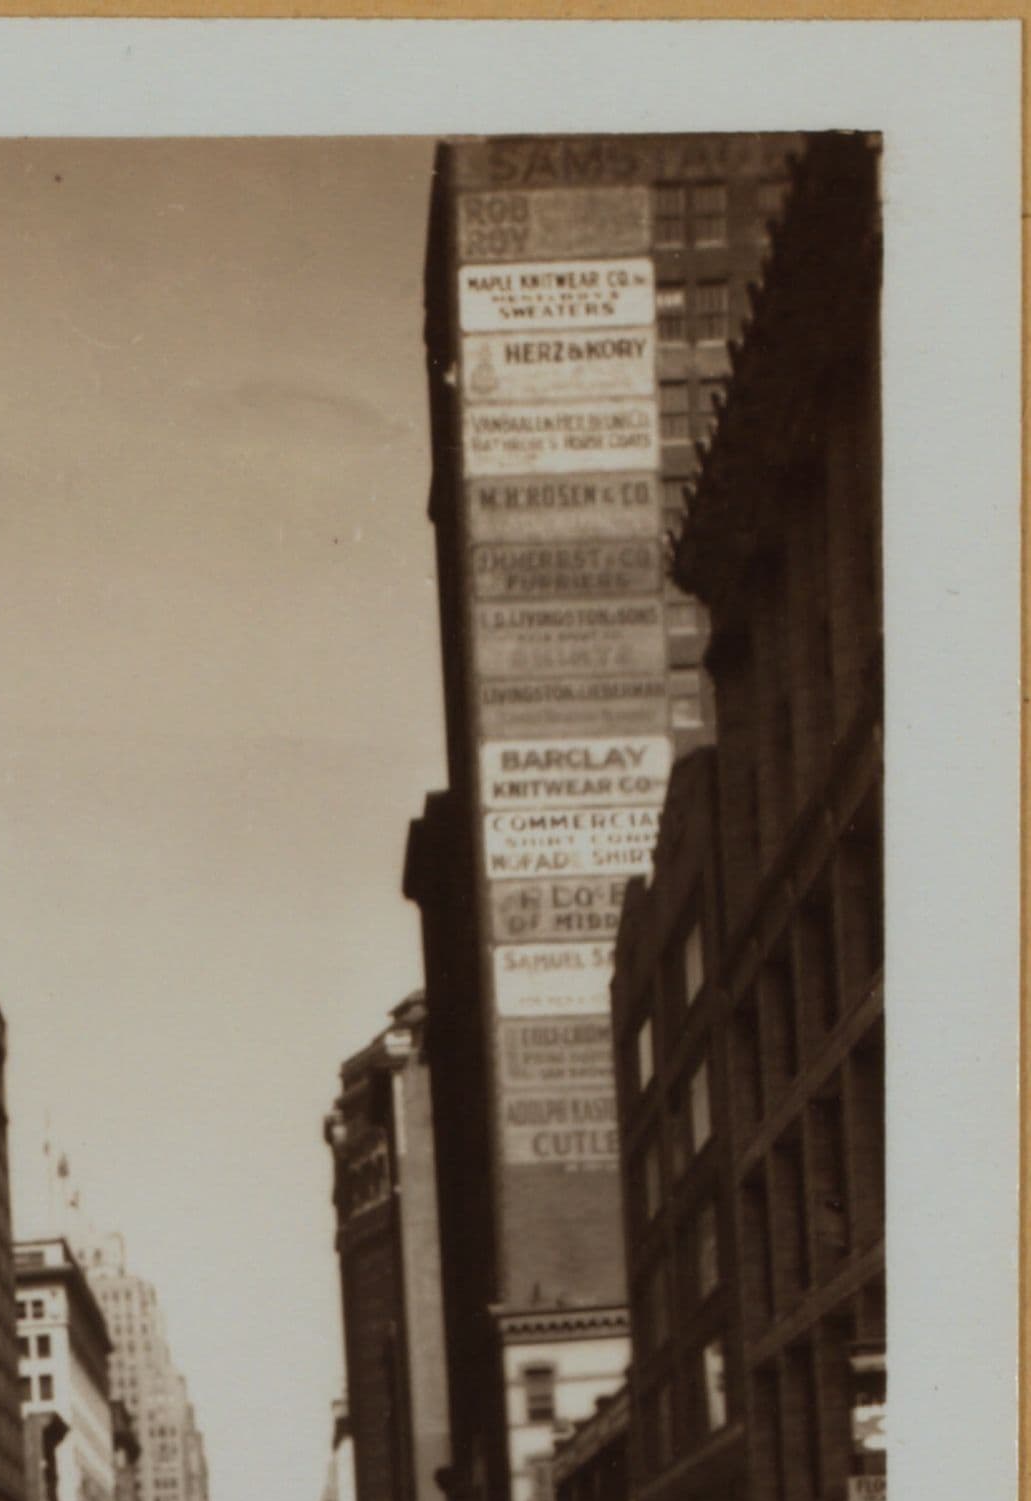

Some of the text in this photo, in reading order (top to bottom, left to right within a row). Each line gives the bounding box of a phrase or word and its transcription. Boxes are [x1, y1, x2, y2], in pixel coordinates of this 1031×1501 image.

[467, 274, 512, 291] MAPLE
[519, 270, 600, 289] KNITWEAR
[497, 302, 615, 320] SWEATERS
[504, 340, 564, 365] HERZ
[501, 744, 649, 771] BARCLAY
[492, 777, 612, 799] KNITWEAR
